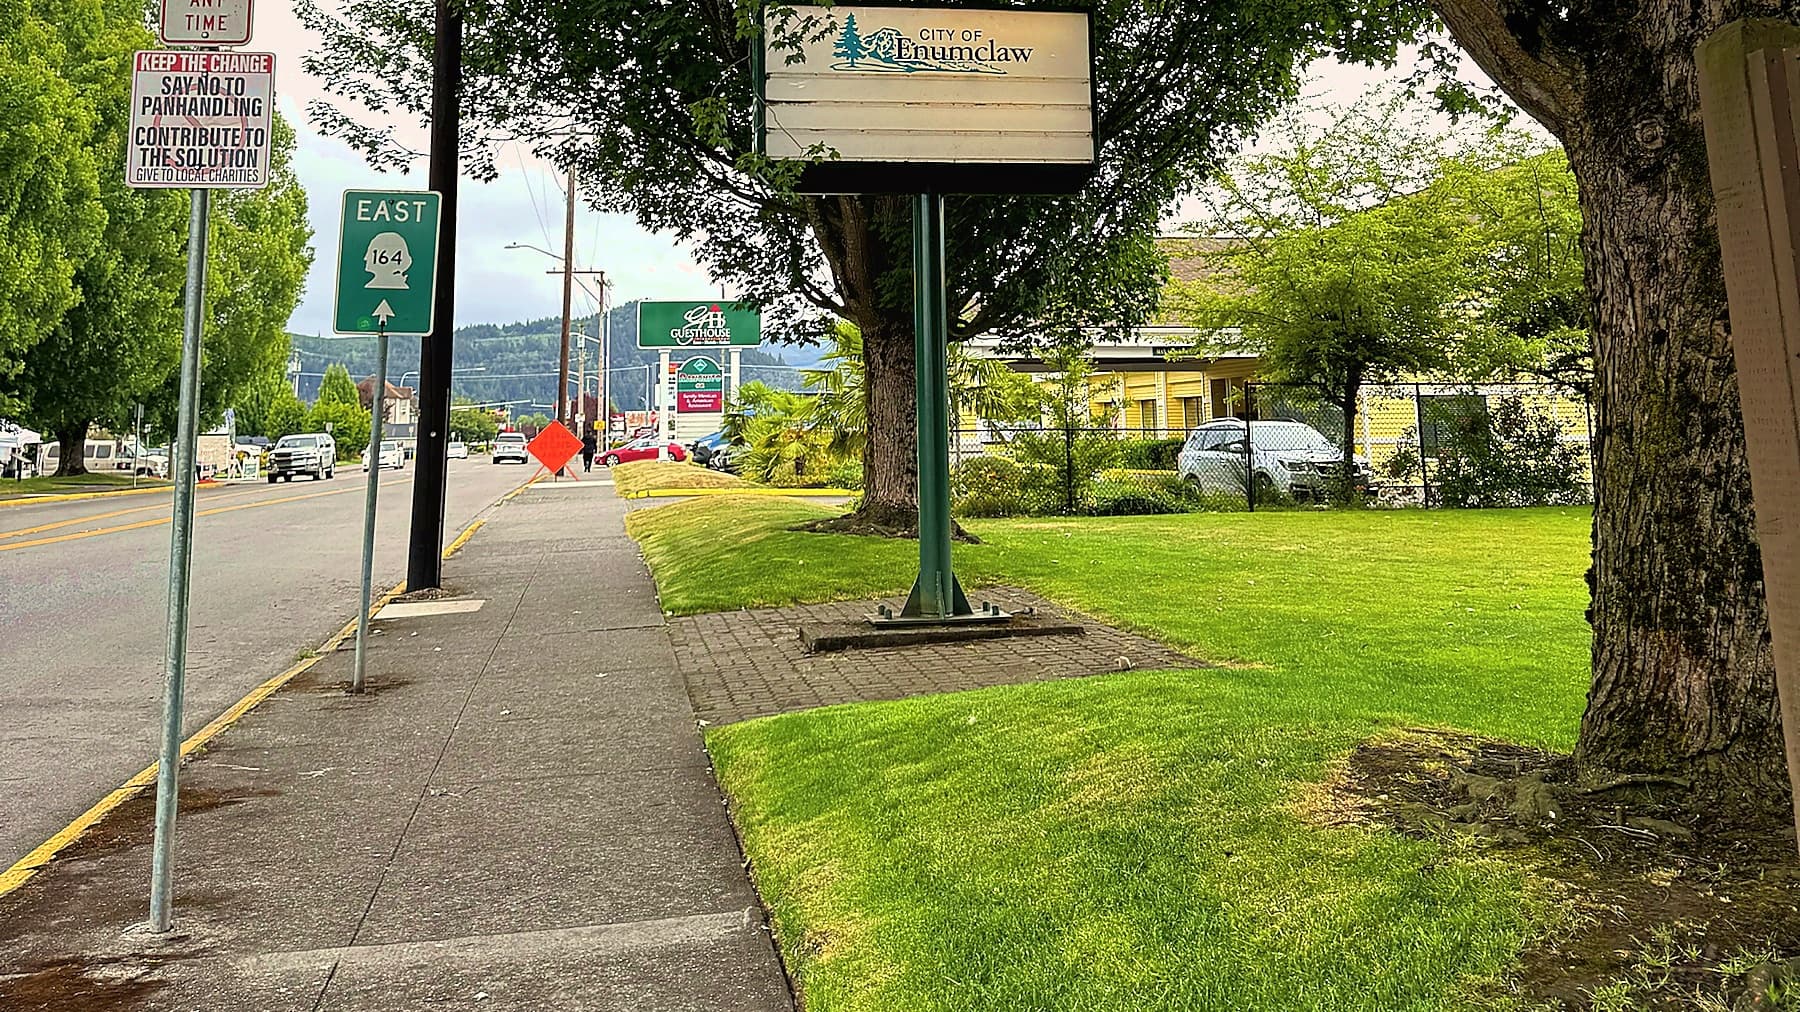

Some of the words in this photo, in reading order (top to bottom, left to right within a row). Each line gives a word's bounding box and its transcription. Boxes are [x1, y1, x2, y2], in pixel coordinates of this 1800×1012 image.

[185, 14, 227, 31] TIME
[920, 29, 955, 41] CITY
[961, 30, 982, 41] OF
[894, 37, 1033, 62] Enumclaw
[140, 54, 177, 71] KEEP
[180, 55, 207, 72] THE
[210, 55, 268, 73] CHANGE
[161, 76, 193, 96] SAY
[197, 76, 221, 96] NO
[225, 77, 246, 97] TO
[141, 96, 262, 117] PANHANDLING
[135, 126, 241, 147] CONTRIBUTE
[244, 128, 265, 147] TO
[140, 148, 172, 167] THE
[175, 148, 258, 168] SOLUTION
[136, 168, 159, 182] GIVE
[162, 169, 174, 182] TO
[175, 168, 206, 182] LOCAL
[208, 168, 259, 182] CHARITIES
[356, 199, 427, 222] EAST
[372, 249, 402, 265] 164
[671, 327, 731, 339] GUESTHOUSE
